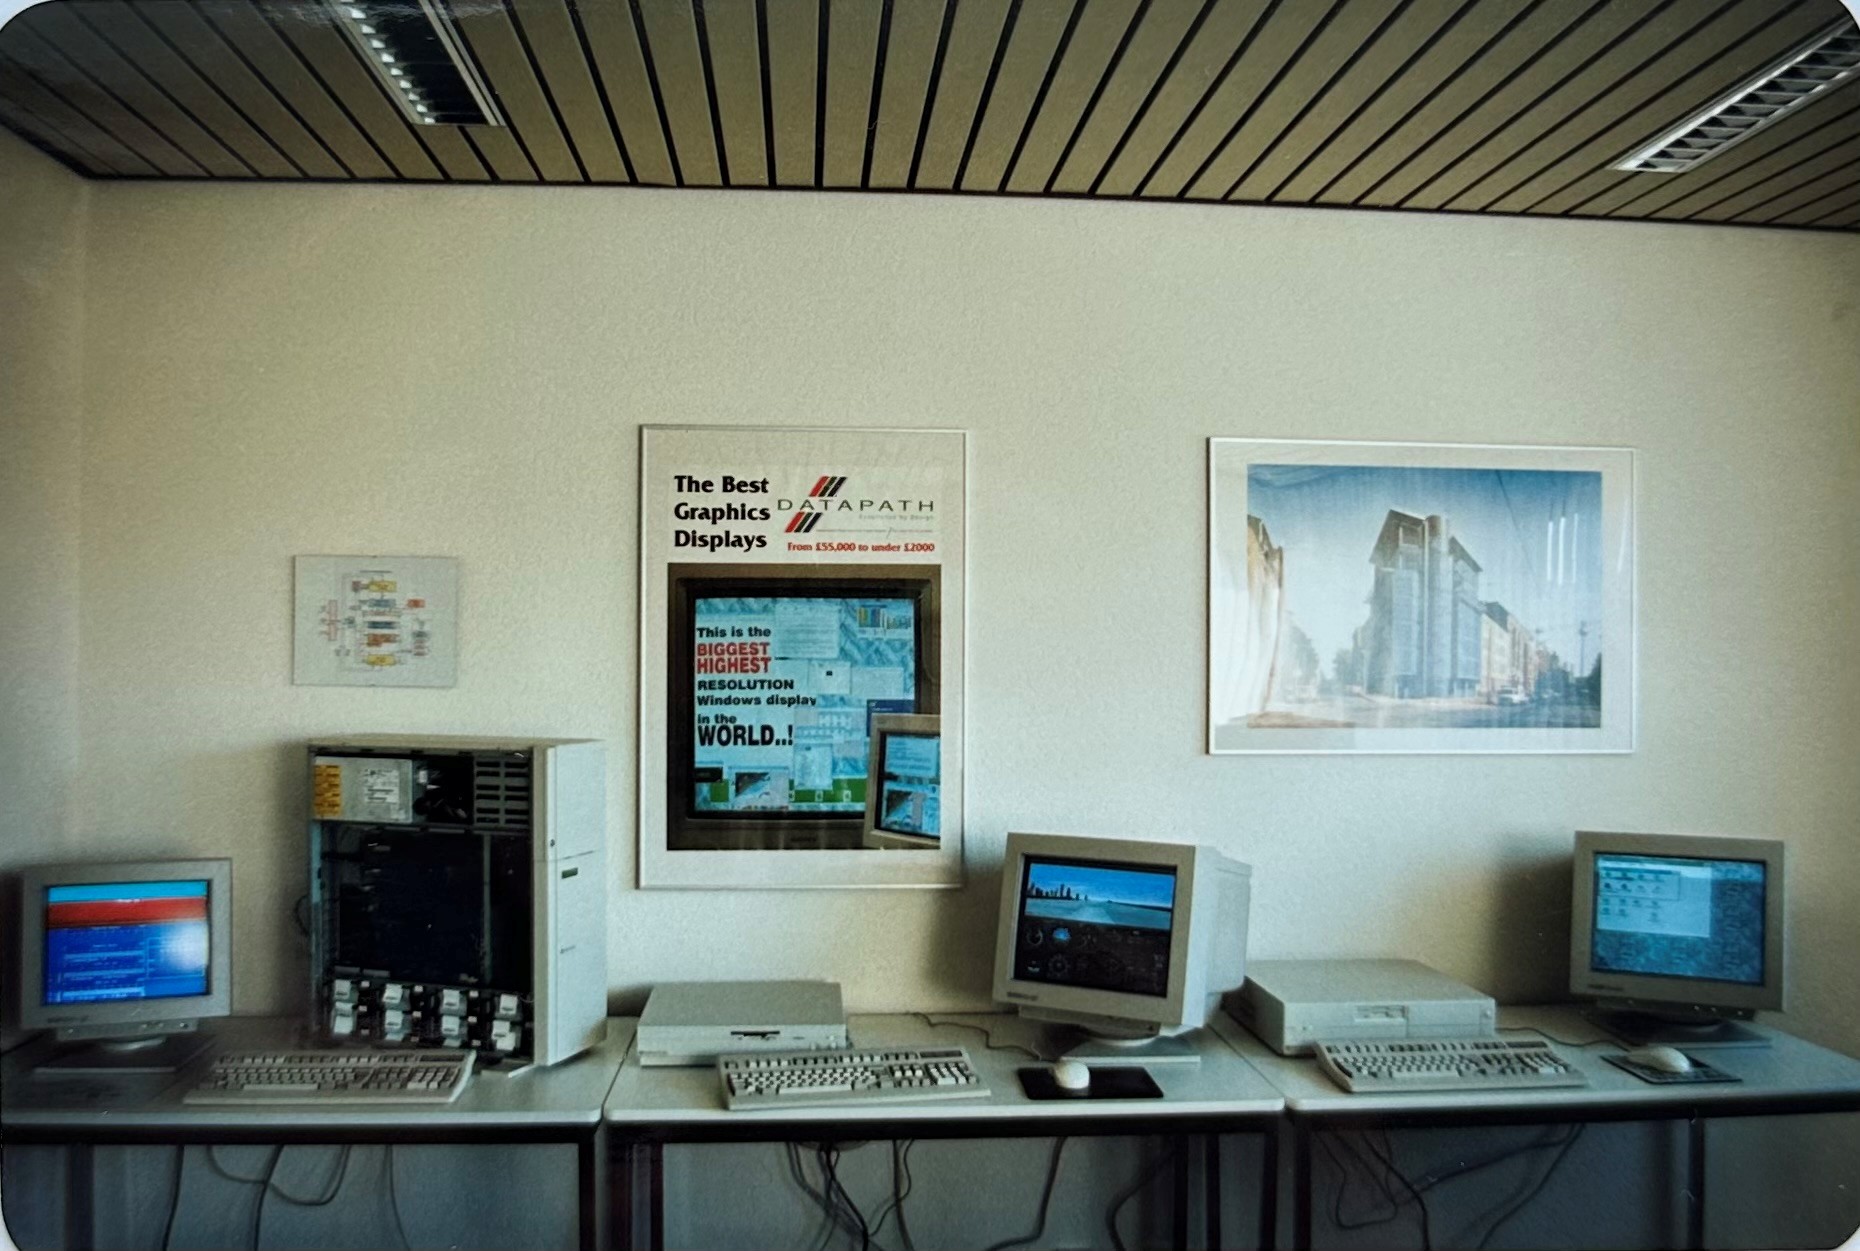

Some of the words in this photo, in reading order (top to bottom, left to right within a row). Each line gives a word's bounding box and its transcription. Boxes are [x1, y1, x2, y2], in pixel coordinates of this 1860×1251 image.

[674, 475, 714, 493] The
[722, 475, 769, 493] Best
[777, 499, 934, 511] DATAPATH
[674, 502, 771, 525] Graphics
[674, 529, 767, 552] Displays
[787, 543, 812, 551] From
[871, 543, 900, 551] under
[904, 543, 935, 552] £2000
[697, 627, 727, 638] This
[731, 626, 743, 637] is
[748, 626, 771, 637] the
[697, 642, 770, 656] BIGGEST
[697, 657, 771, 674] HIGHEST
[697, 679, 794, 690] RESOLUTION
[697, 695, 761, 706] Windows
[766, 694, 816, 707] display
[697, 714, 710, 724] in
[714, 714, 737, 724] the
[697, 724, 793, 746] WORLD..!
